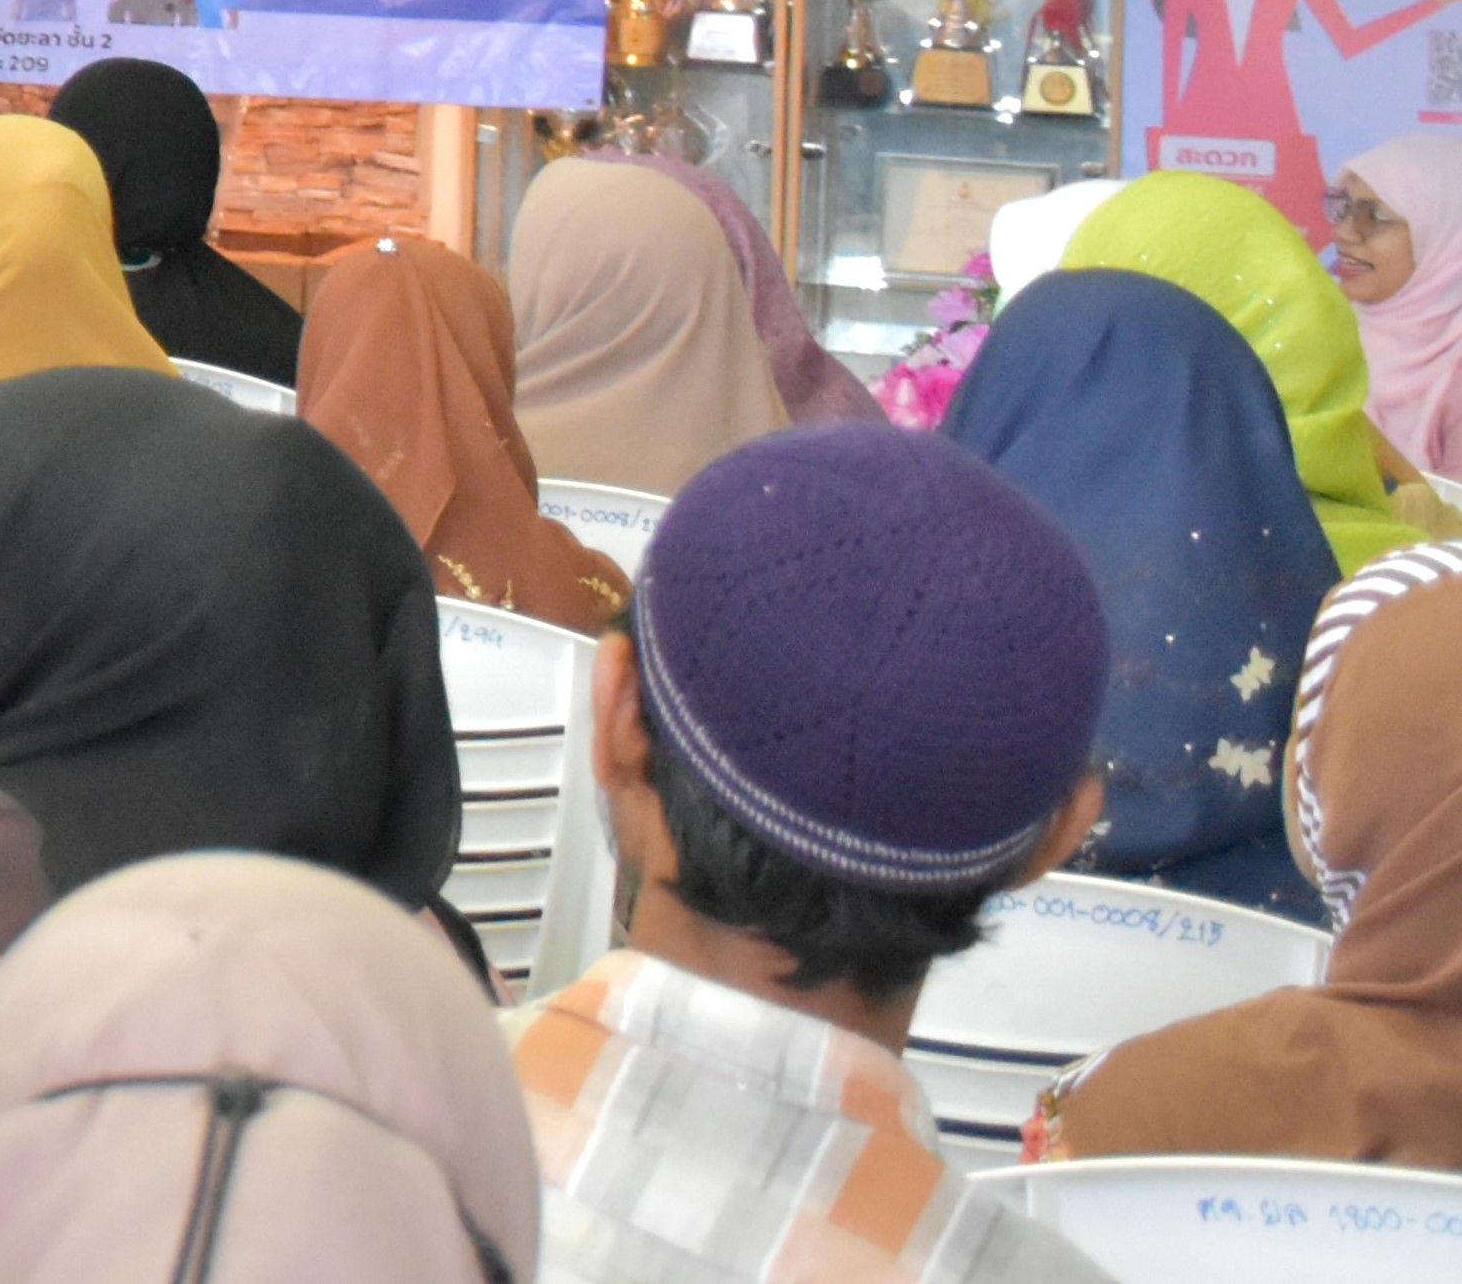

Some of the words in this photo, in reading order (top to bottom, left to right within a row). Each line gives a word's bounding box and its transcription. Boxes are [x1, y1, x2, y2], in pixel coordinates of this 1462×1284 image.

[67, 23, 94, 48] ชั้น
[101, 34, 112, 49] 2
[10, 56, 49, 72] 209
